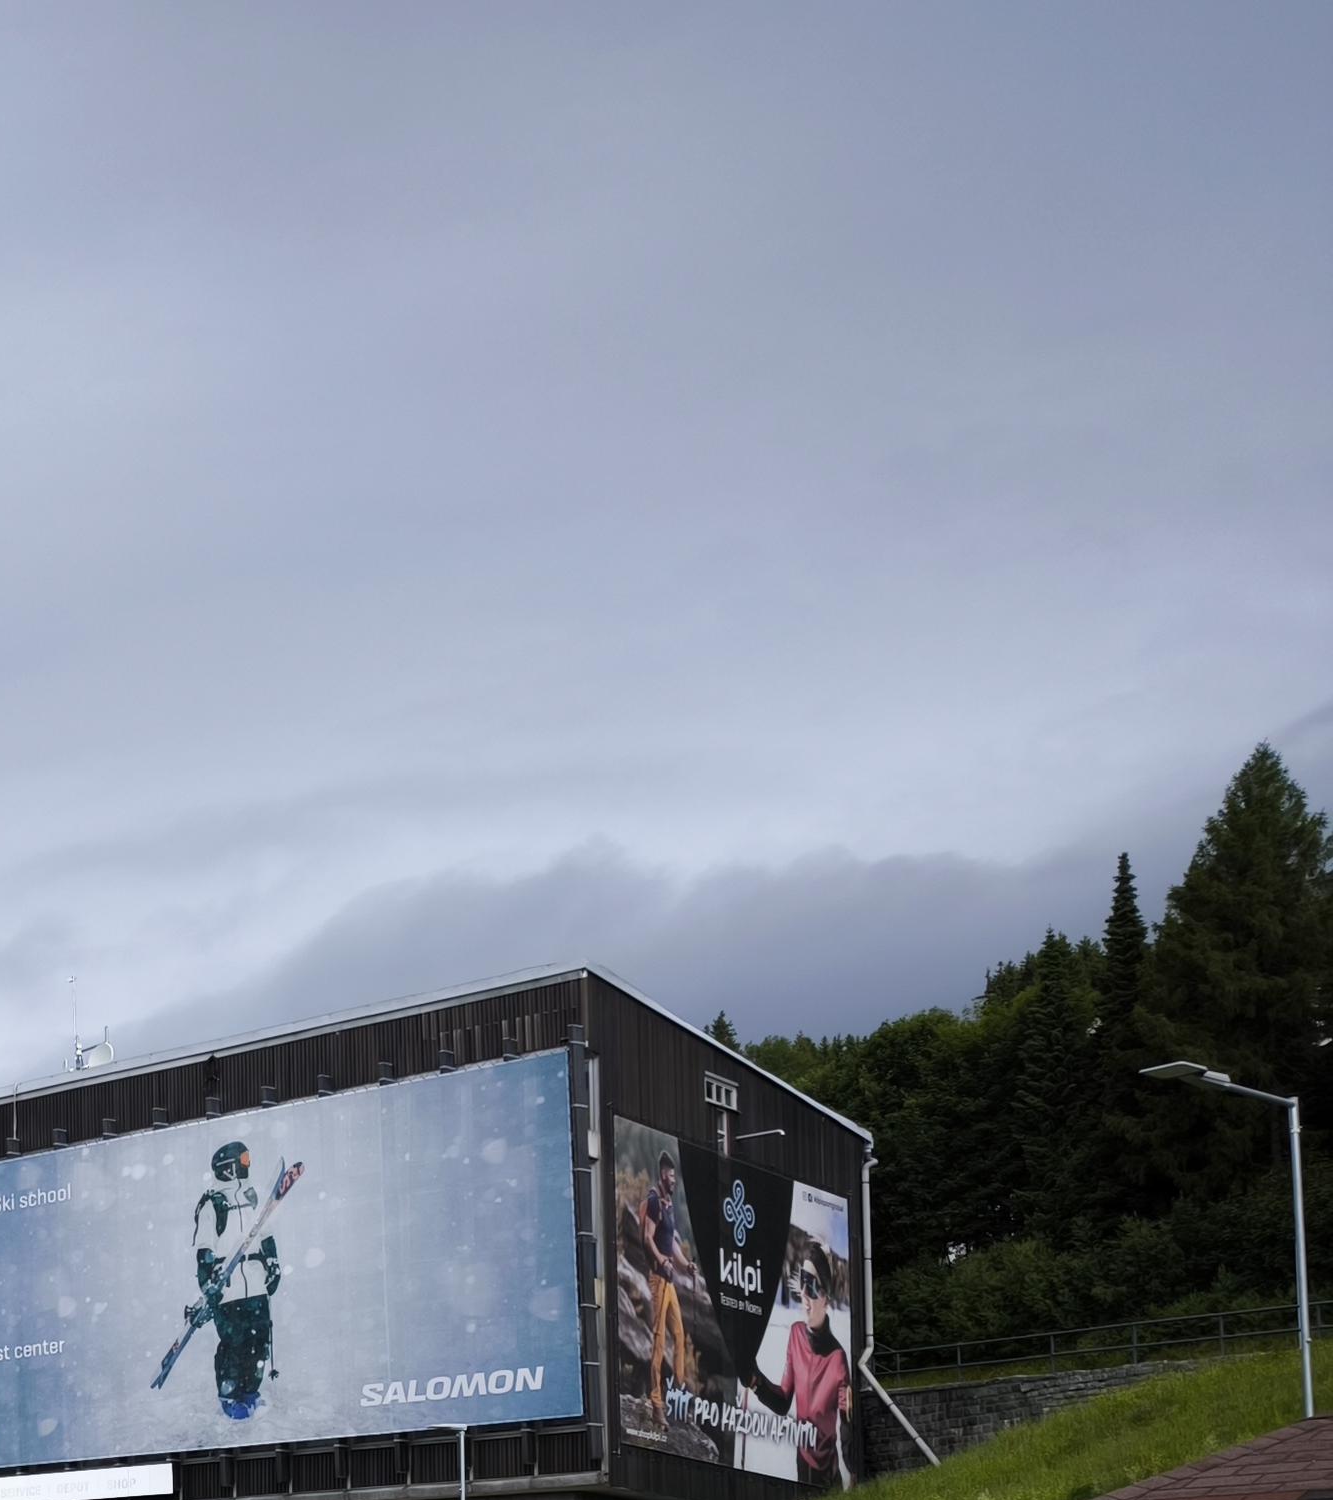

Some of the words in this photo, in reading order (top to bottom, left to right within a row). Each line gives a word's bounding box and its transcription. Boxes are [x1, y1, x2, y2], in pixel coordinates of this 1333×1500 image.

[19, 1183, 72, 1209] school
[719, 1247, 762, 1297] kilpi
[14, 1339, 66, 1359] center
[360, 1366, 544, 1407] SALOMON
[694, 1397, 719, 1427] PRO
[721, 1395, 769, 1437] KAŽDOU
